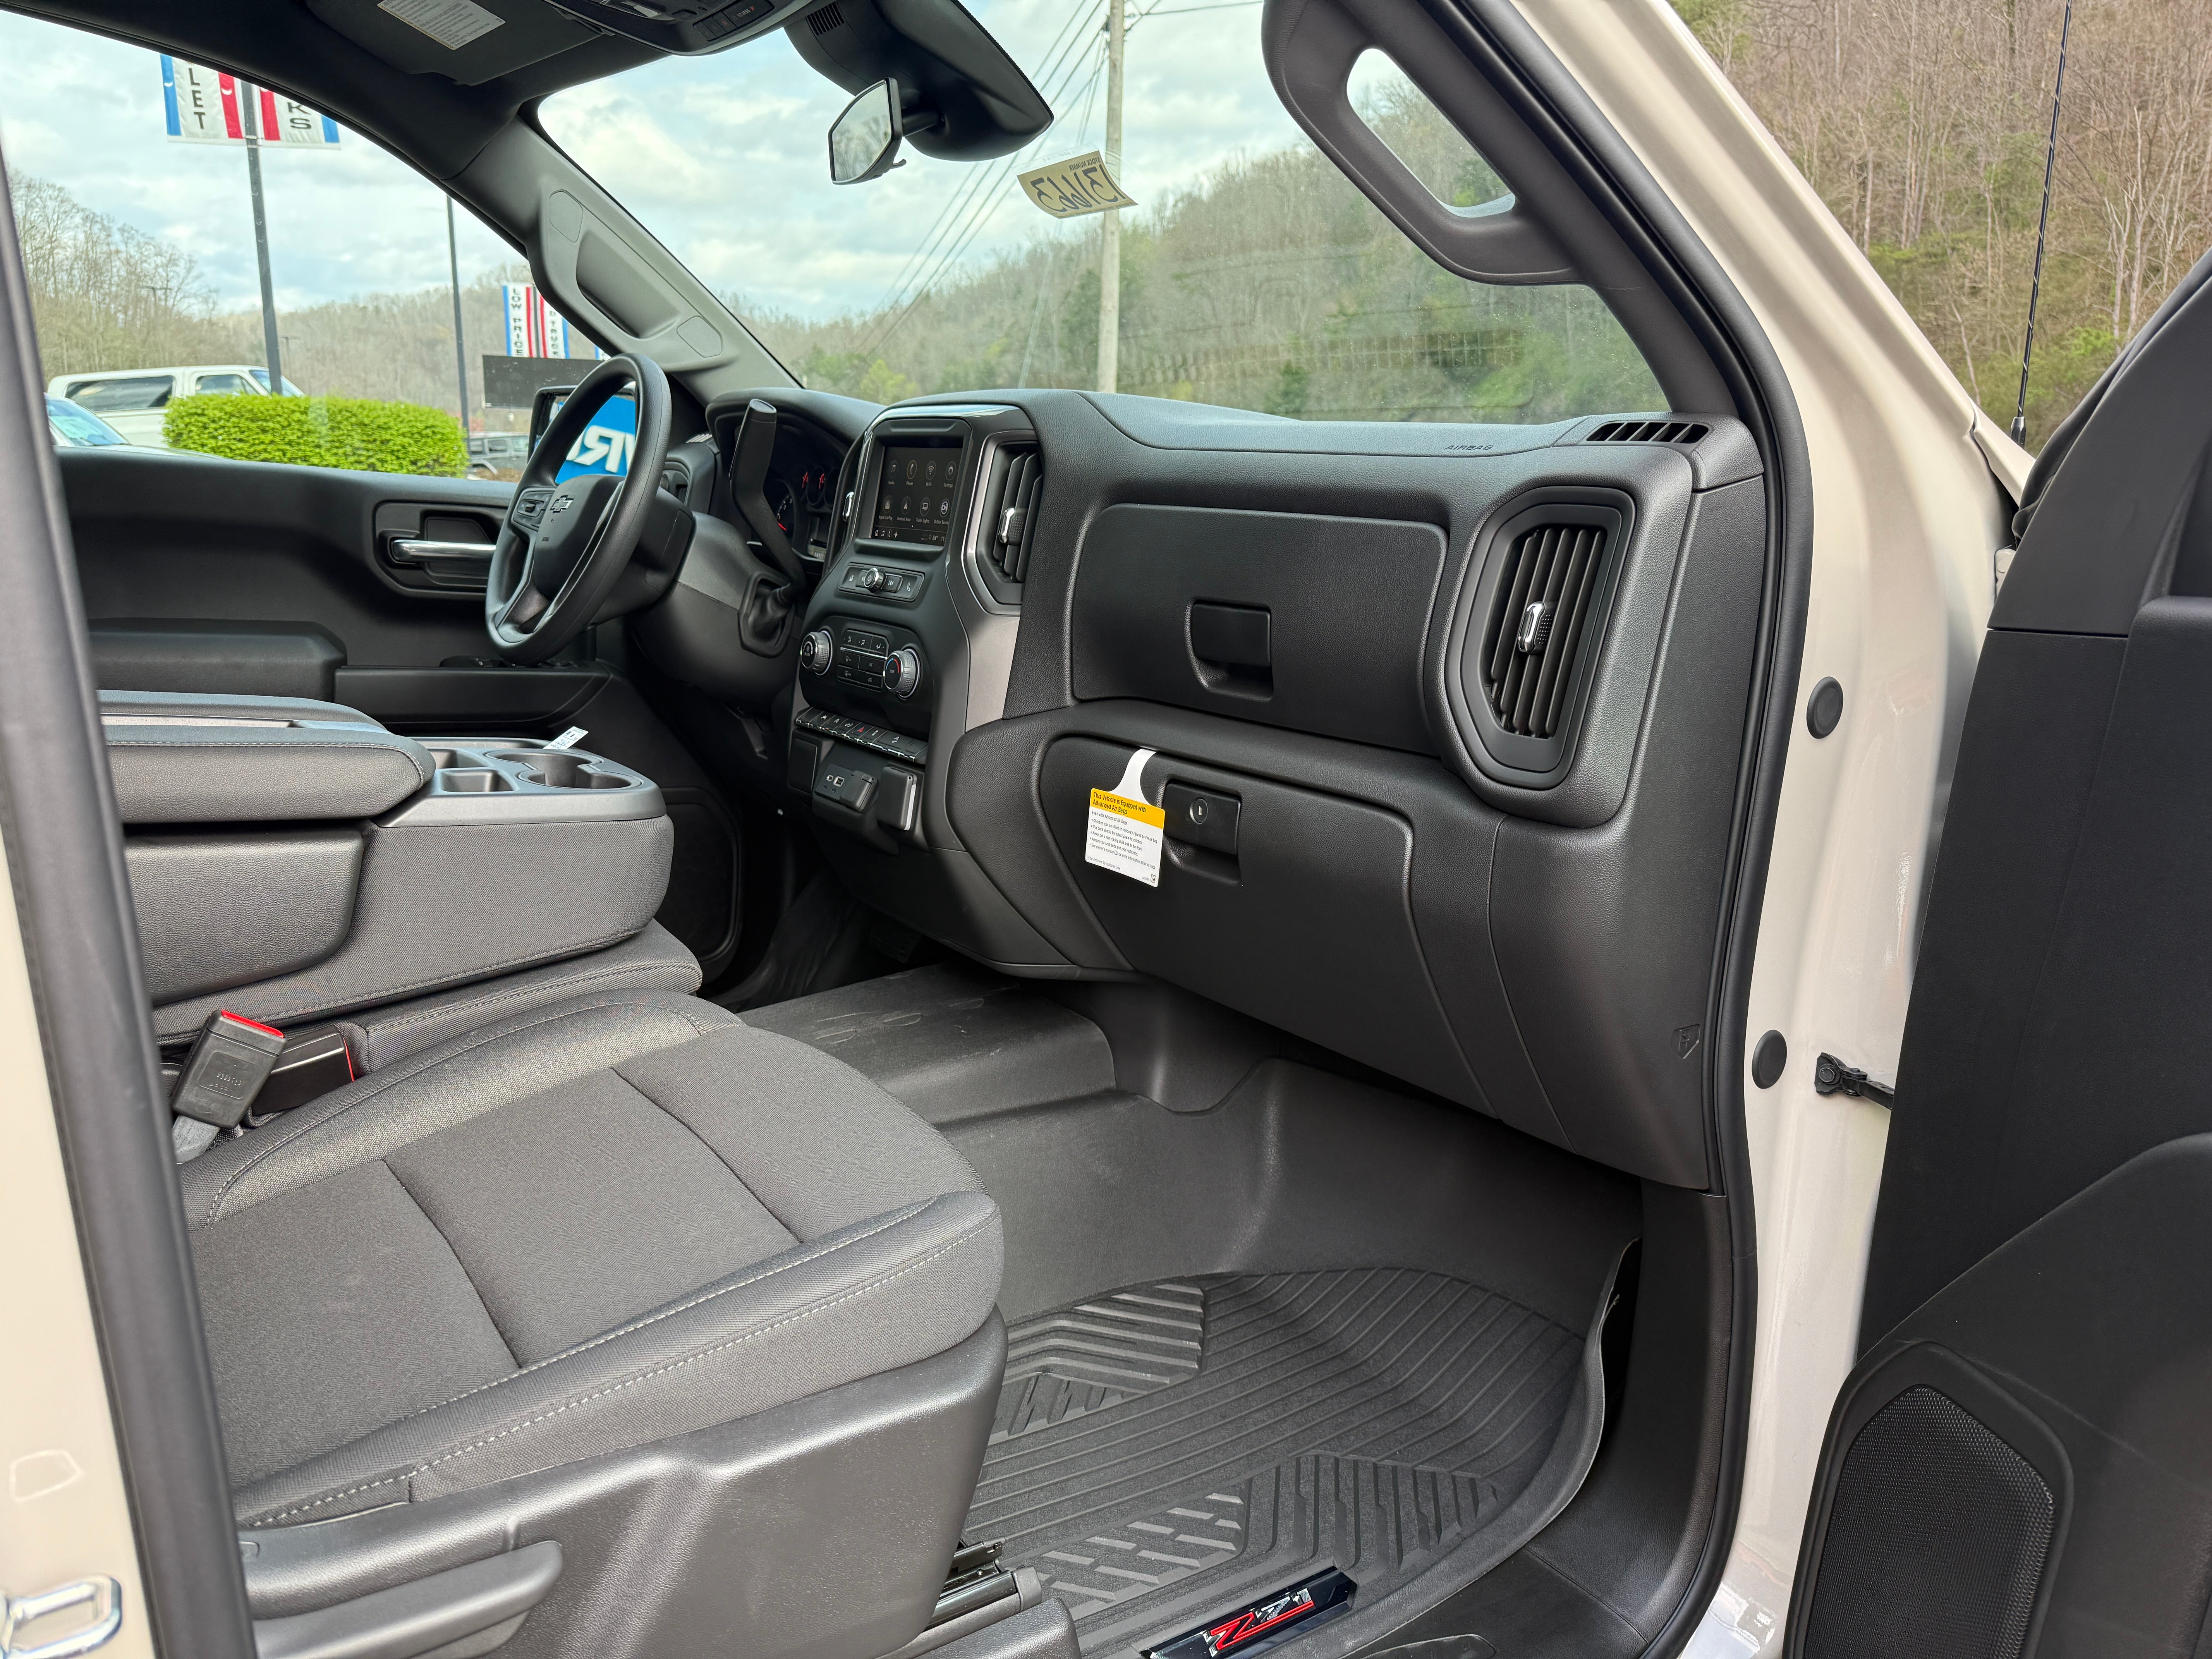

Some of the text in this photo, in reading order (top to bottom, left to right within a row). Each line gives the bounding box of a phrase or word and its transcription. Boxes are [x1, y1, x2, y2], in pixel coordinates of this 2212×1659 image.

[511, 288, 522, 309] LOW
[1093, 799, 1111, 809] Advanced
[1118, 807, 1127, 815] Bags
[1103, 794, 1116, 803] Vehicle
[1121, 800, 1137, 810] Equipped
[1210, 1588, 1315, 1651] Z71
